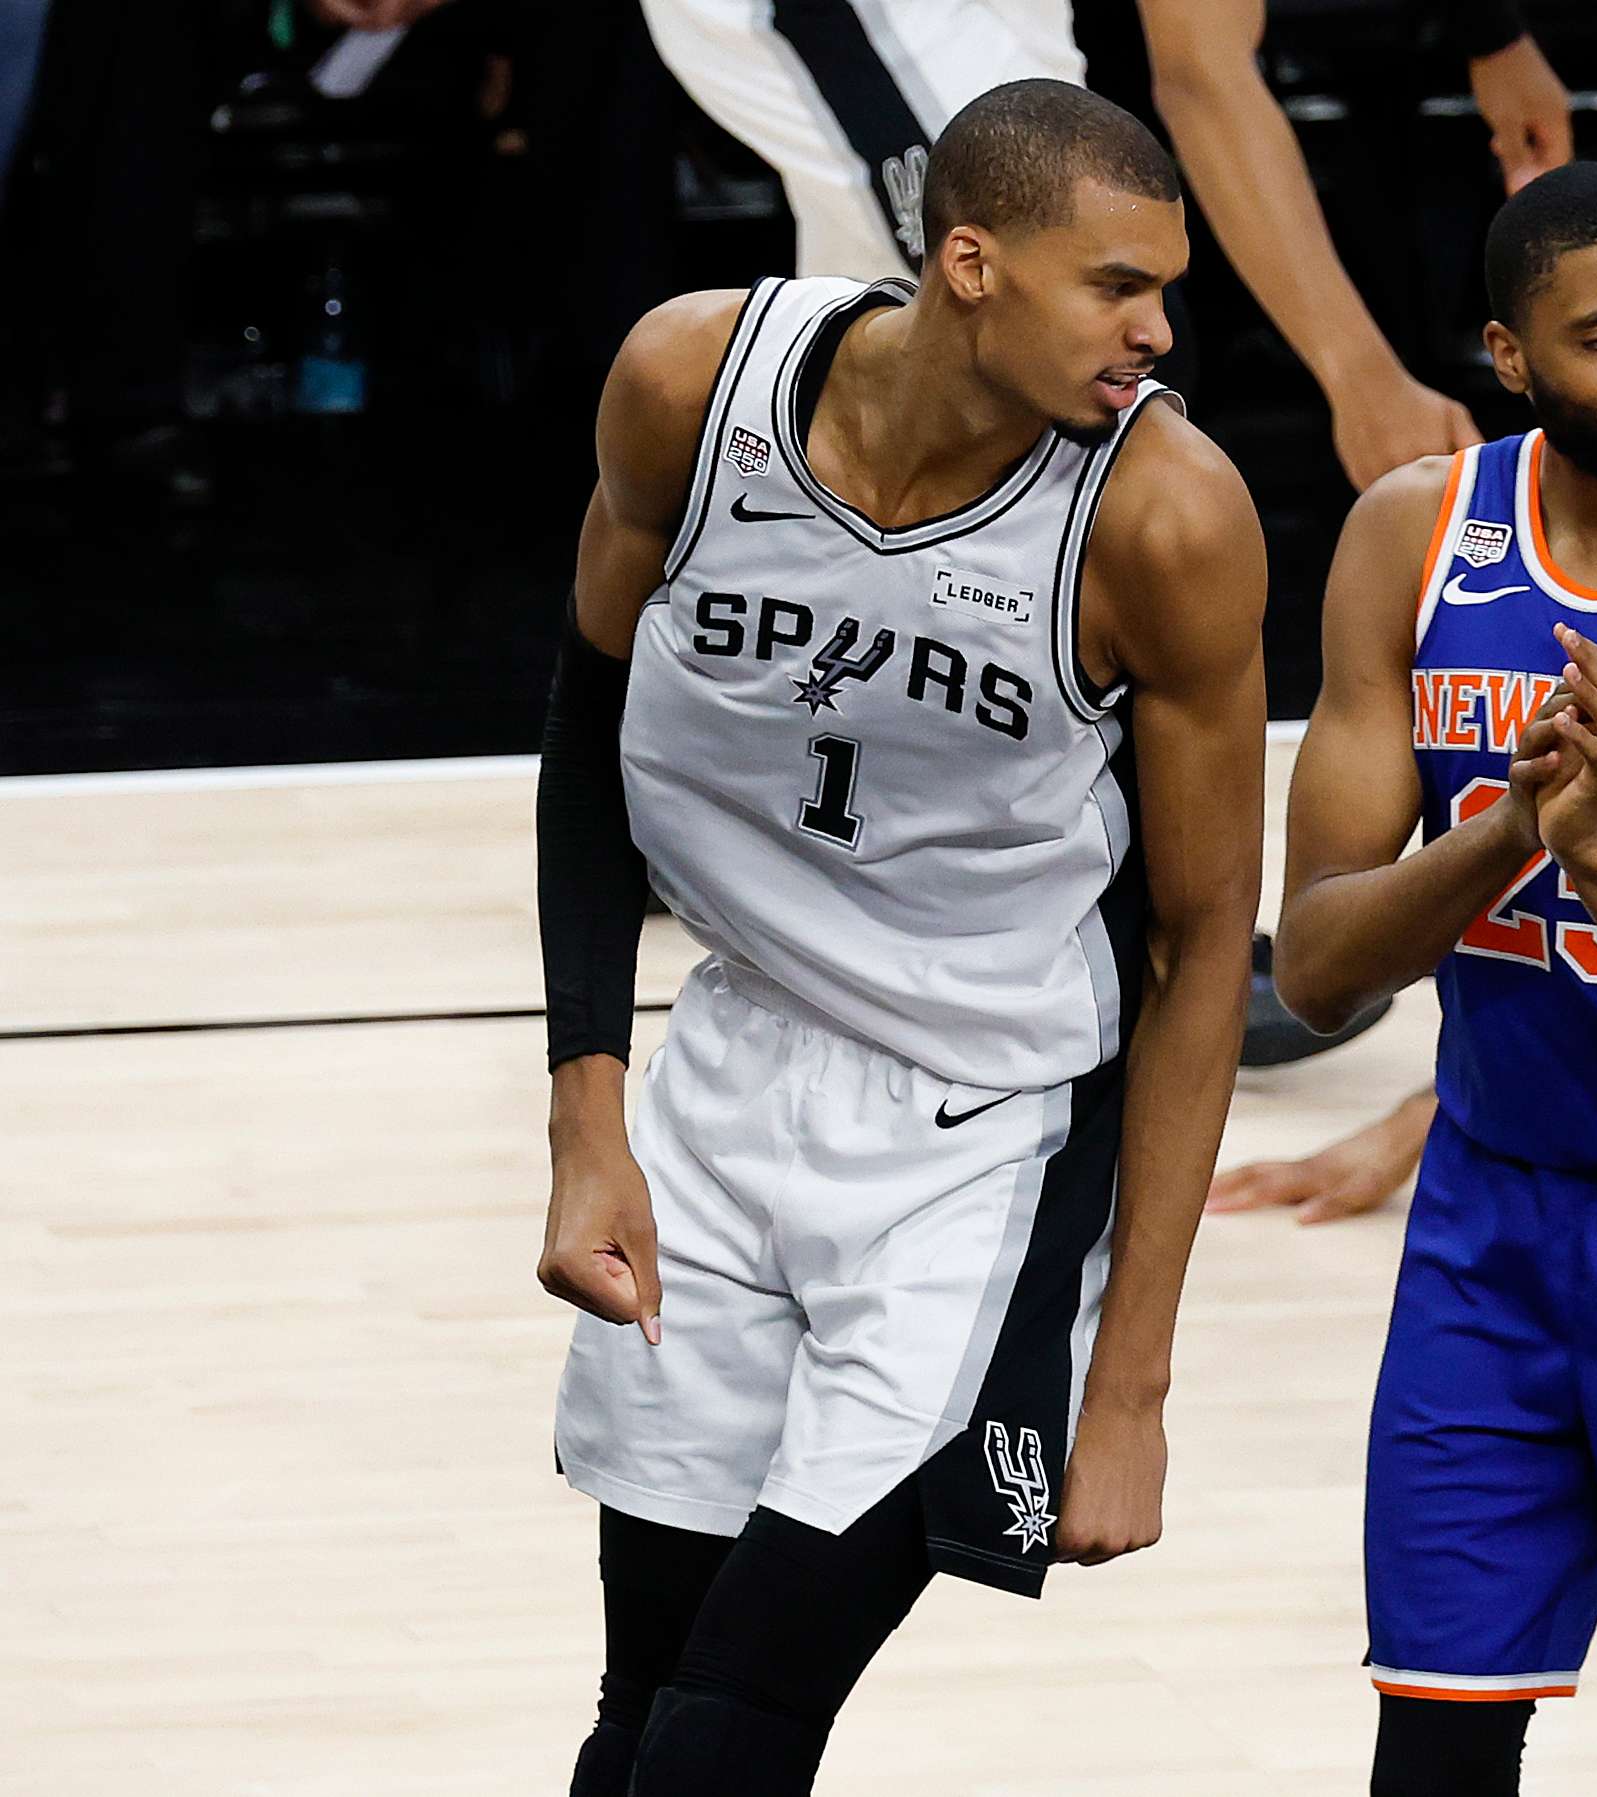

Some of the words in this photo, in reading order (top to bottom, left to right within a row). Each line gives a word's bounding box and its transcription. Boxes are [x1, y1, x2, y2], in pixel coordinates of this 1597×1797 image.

[735, 429, 768, 454] USA
[727, 446, 767, 472] 250
[1467, 525, 1504, 540] USA
[1460, 541, 1501, 559] 250
[946, 583, 1019, 613] LEDGER
[693, 591, 1033, 741] SPURS
[1412, 668, 1565, 754] NEW
[798, 732, 864, 852] 1
